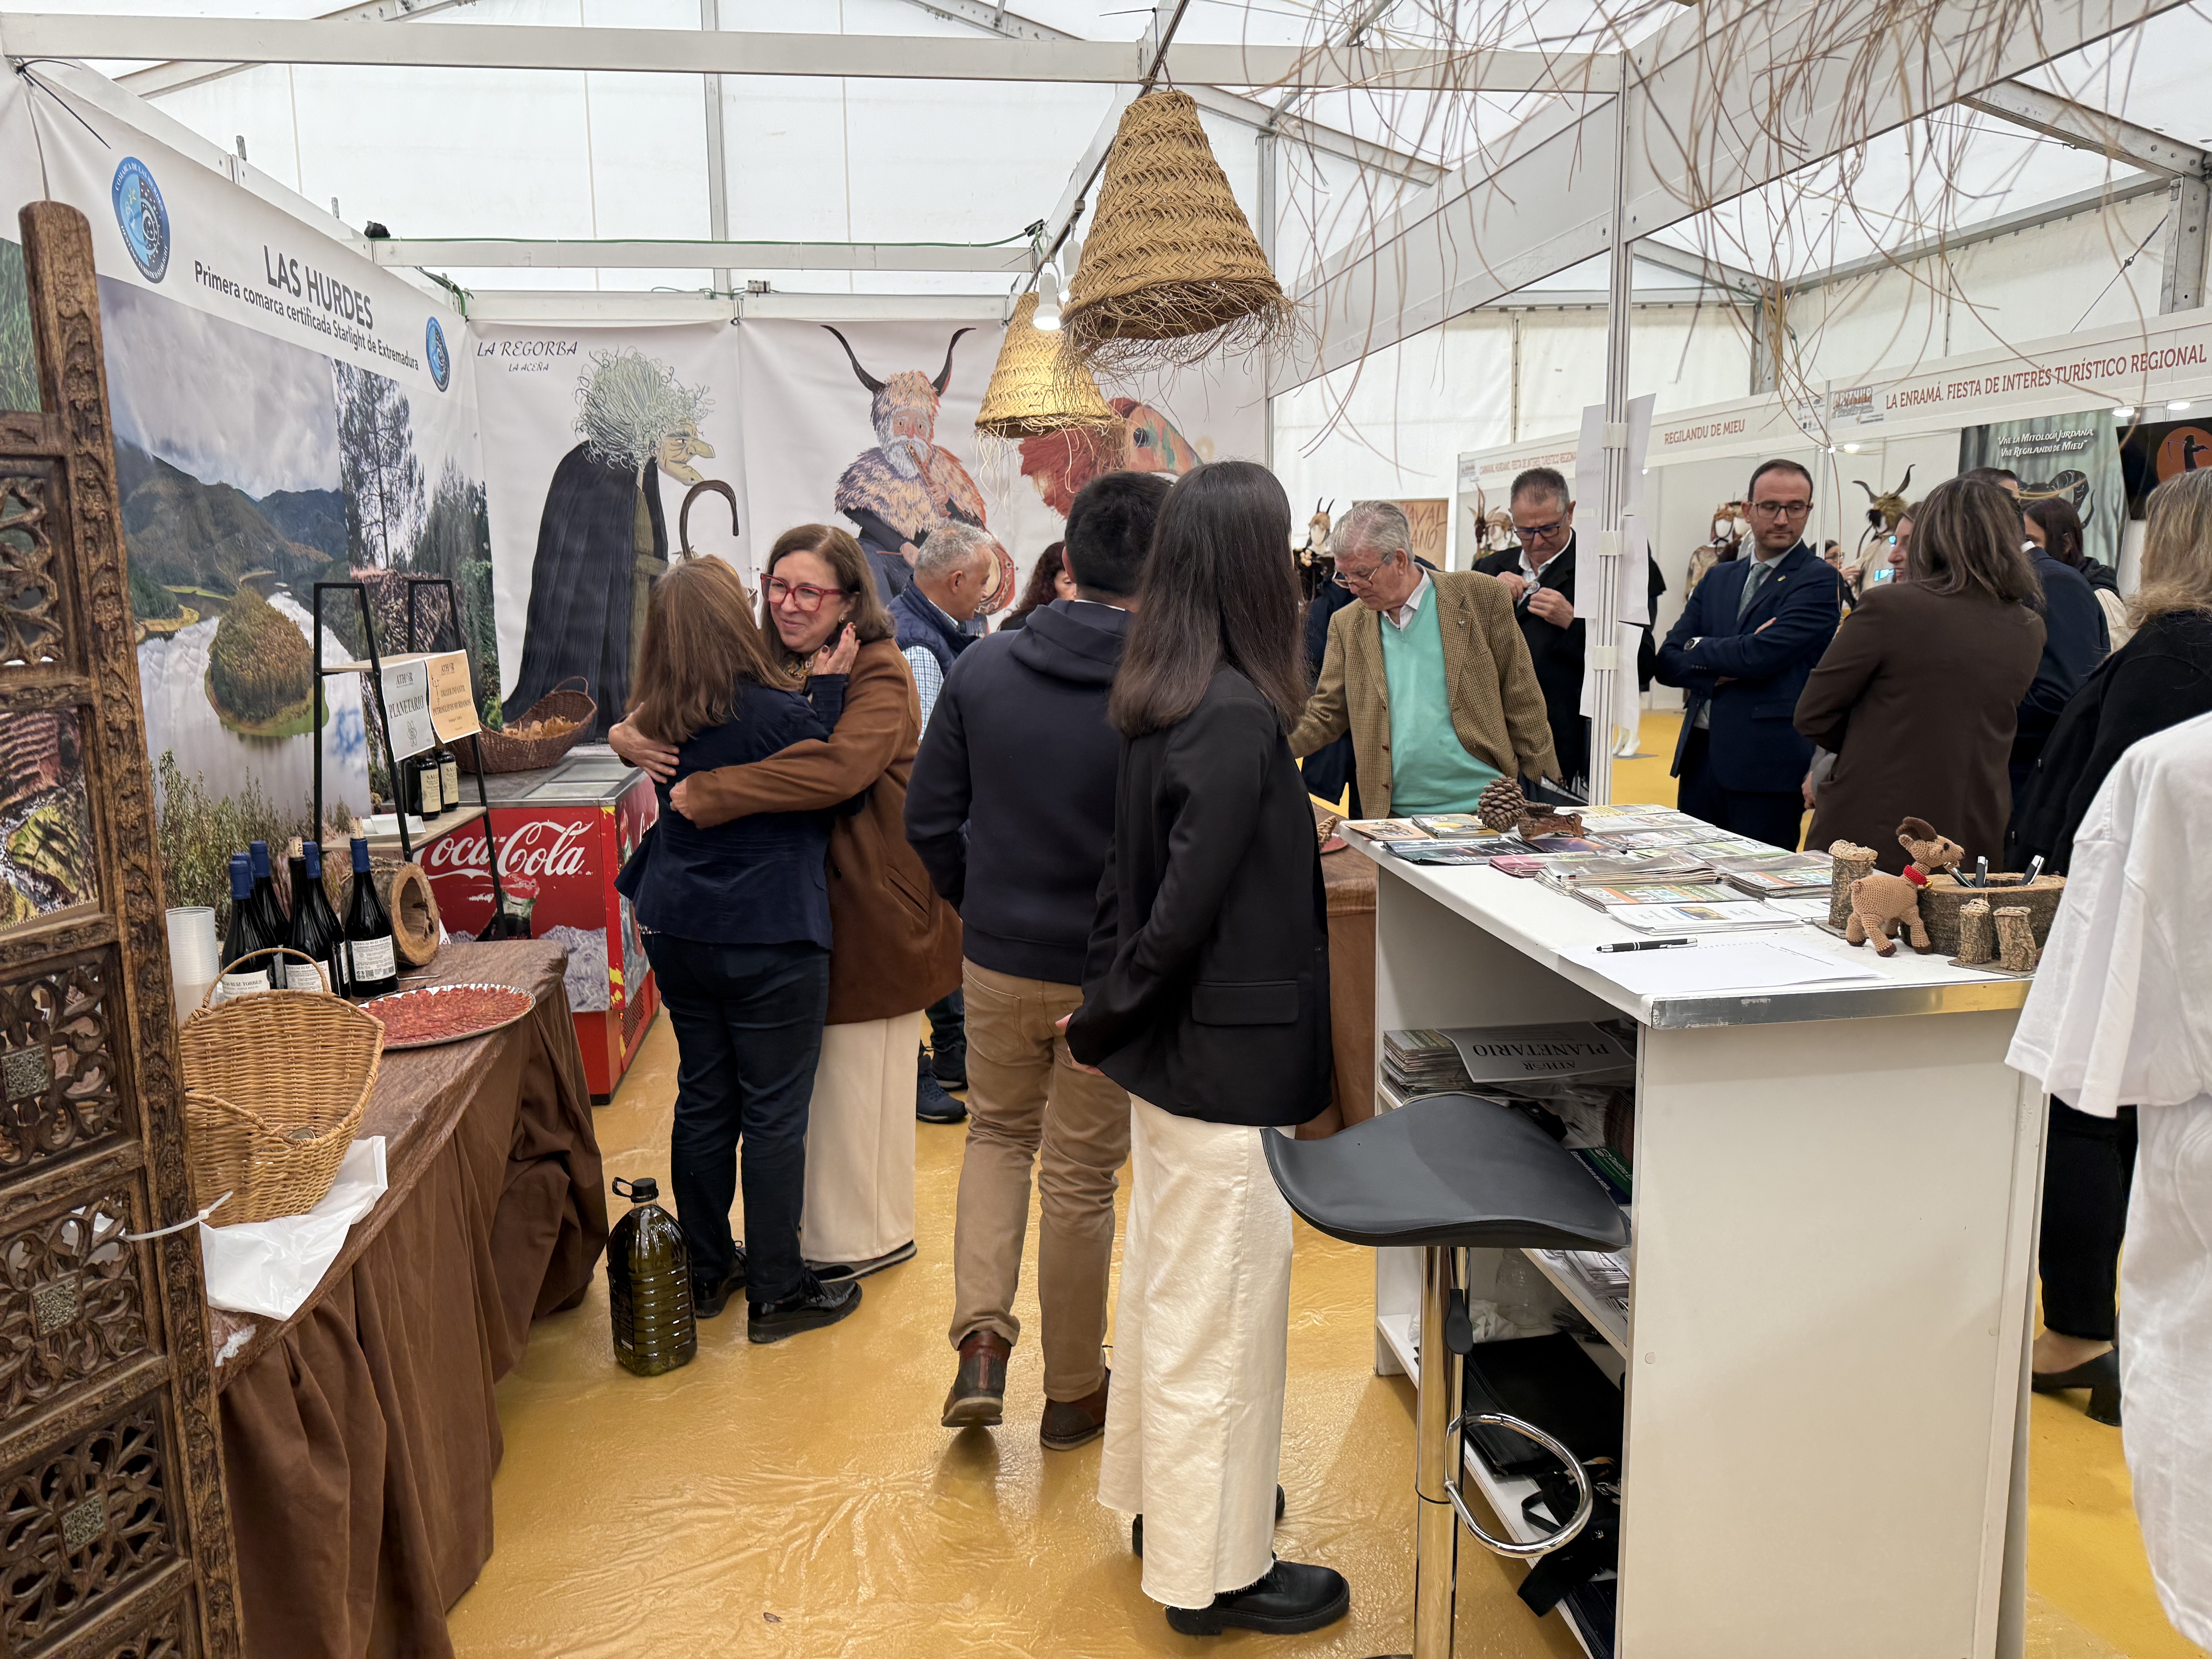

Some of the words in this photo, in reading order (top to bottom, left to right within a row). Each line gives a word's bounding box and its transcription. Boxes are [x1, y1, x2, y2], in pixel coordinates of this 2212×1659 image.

[264, 244, 301, 298] LAS
[305, 265, 373, 330] HURDES
[194, 260, 240, 299] Primera
[243, 287, 284, 316] comarca
[287, 305, 331, 335] certificada
[333, 319, 366, 351] Starlight
[367, 333, 376, 354] de
[378, 338, 419, 371] Extremadura
[477, 342, 496, 356] LA
[500, 340, 577, 357] REGORBA
[508, 363, 519, 372] LA
[520, 362, 549, 372] ACEÑA
[1886, 393, 1898, 410] LA
[1900, 381, 1944, 407] ENRAMÁ.
[1947, 379, 1982, 400] FIESTA
[1985, 376, 2000, 395] DE
[2002, 364, 2052, 392] INTERÉS
[2055, 356, 2127, 385] TURÍSTICO
[2131, 343, 2207, 373] REGIONAL
[1665, 425, 1709, 445] REGILANDU
[1711, 423, 1721, 437] DE
[1723, 419, 1745, 435] MIEU
[2052, 444, 2061, 452] DE
[388, 695, 424, 719] PLANETARIO
[1473, 1043, 1611, 1056] PLANETARIO
